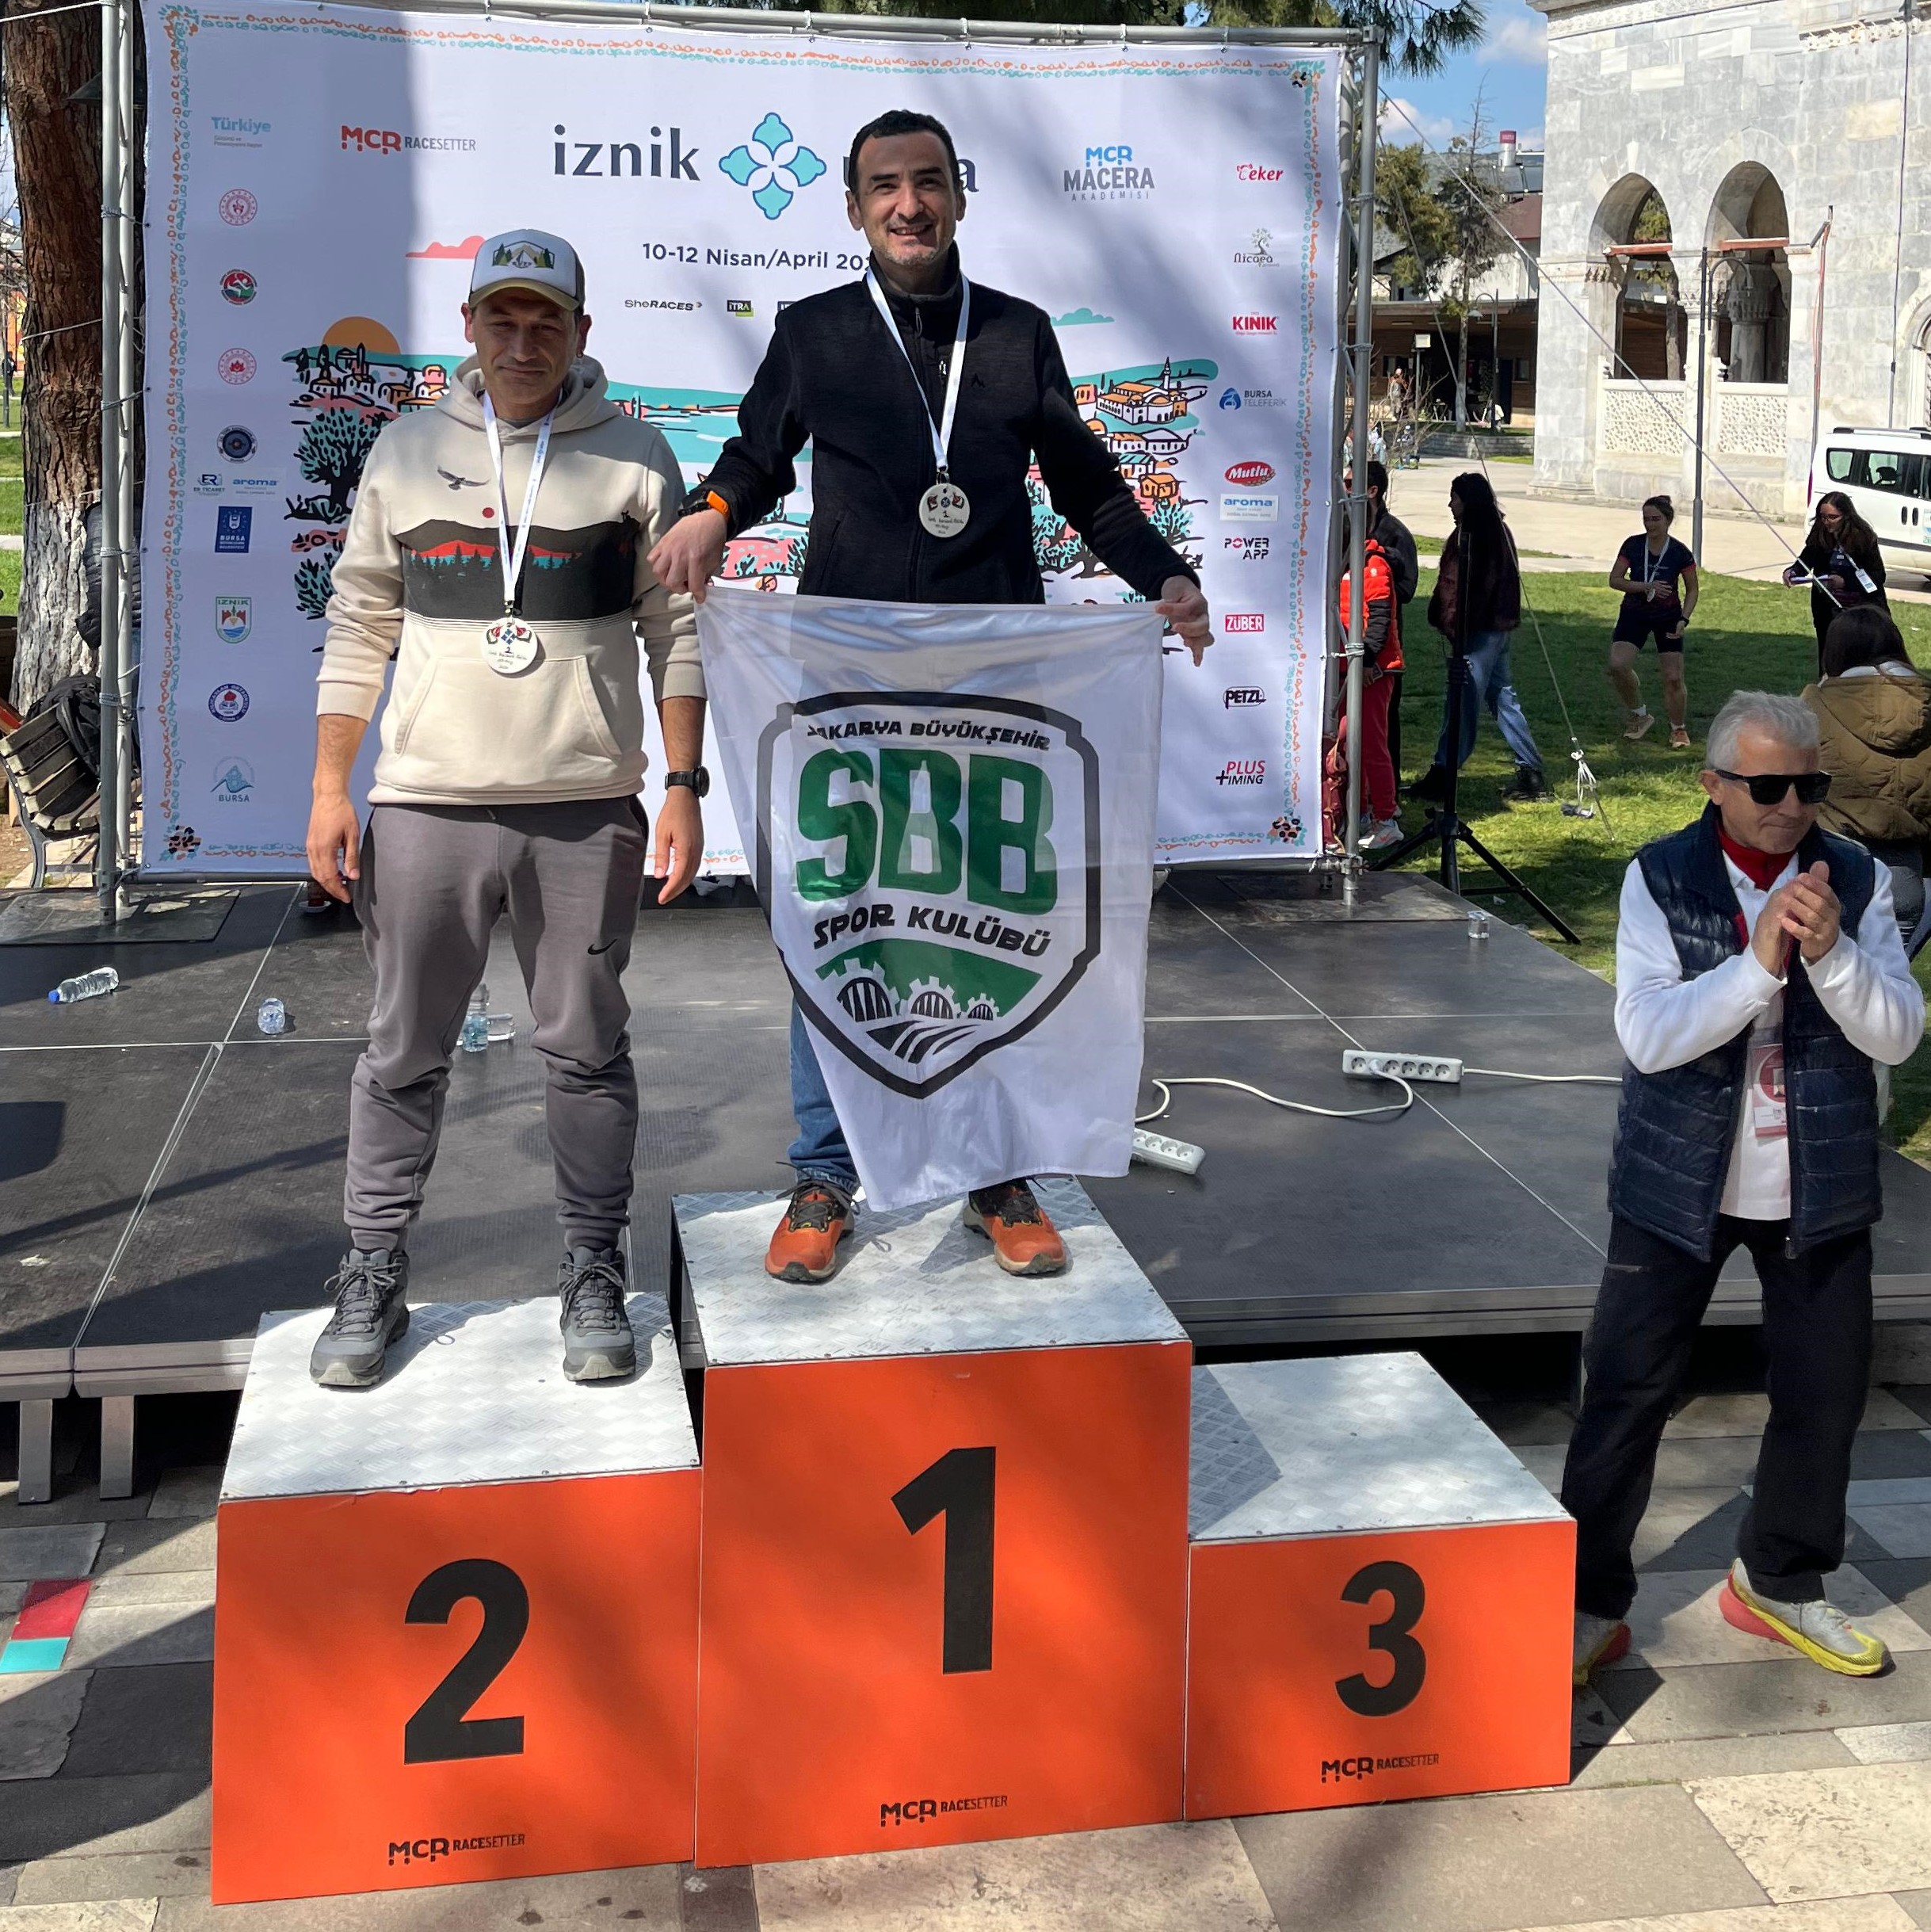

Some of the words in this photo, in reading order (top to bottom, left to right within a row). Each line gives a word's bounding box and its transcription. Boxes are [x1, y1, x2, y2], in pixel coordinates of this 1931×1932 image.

[211, 116, 272, 135] Türkiye
[341, 125, 402, 155] MCR
[405, 136, 476, 151] RACESETTER
[554, 124, 701, 181] iznik
[1086, 145, 1133, 167] MCR
[1063, 166, 1155, 192] MACERA
[643, 242, 698, 263] 10-12
[707, 248, 828, 270] Nisan/April
[624, 300, 694, 311] SheRACES
[1232, 316, 1277, 330] KINIK
[1244, 390, 1273, 399] BURSA
[1228, 465, 1269, 480] Mutlu
[1223, 498, 1273, 507] aroma
[1224, 537, 1269, 548] POWER
[1242, 549, 1269, 560] APP
[1227, 615, 1264, 631] ZÜBER
[1225, 689, 1267, 709] PETZL
[910, 720, 1051, 751] BÜYÜKŞEHİR
[1226, 760, 1266, 775] PLUS
[796, 747, 1059, 916] SBB
[813, 903, 895, 950] SPOR
[907, 906, 1052, 957] KULÜBÜ
[891, 1446, 996, 1675] 1
[1335, 1560, 1426, 1716] 3
[404, 1559, 530, 1765] 2
[1321, 1756, 1375, 1783] MCR
[1376, 1753, 1440, 1770] RACESETTER
[880, 1799, 937, 1827] MCR
[941, 1795, 1009, 1813] RACESETTER
[388, 1837, 450, 1866] MCR
[452, 1833, 526, 1852] RACESETTER
